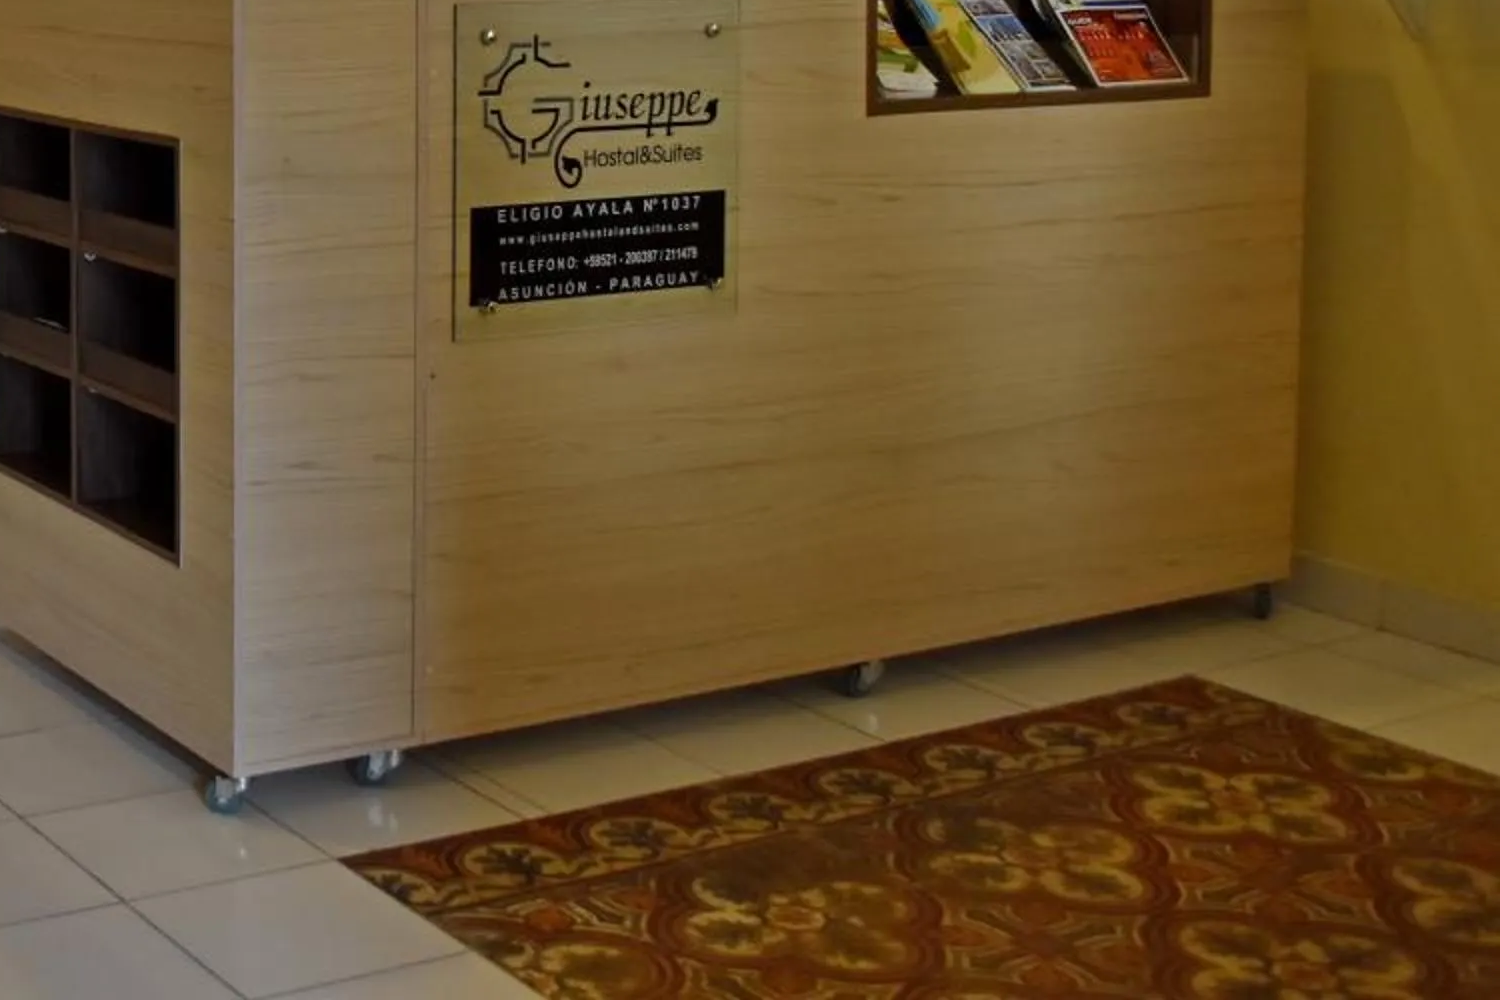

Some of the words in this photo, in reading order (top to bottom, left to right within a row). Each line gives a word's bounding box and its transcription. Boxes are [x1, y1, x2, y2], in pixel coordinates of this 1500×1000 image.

[477, 34, 702, 164] Giuseppe
[583, 144, 703, 169] Hostal&Suites
[497, 205, 563, 223] ELIGIO
[572, 200, 634, 218] AYALA
[499, 278, 588, 300] ASUNCIÓN
[609, 271, 699, 291] PARAGUAY
